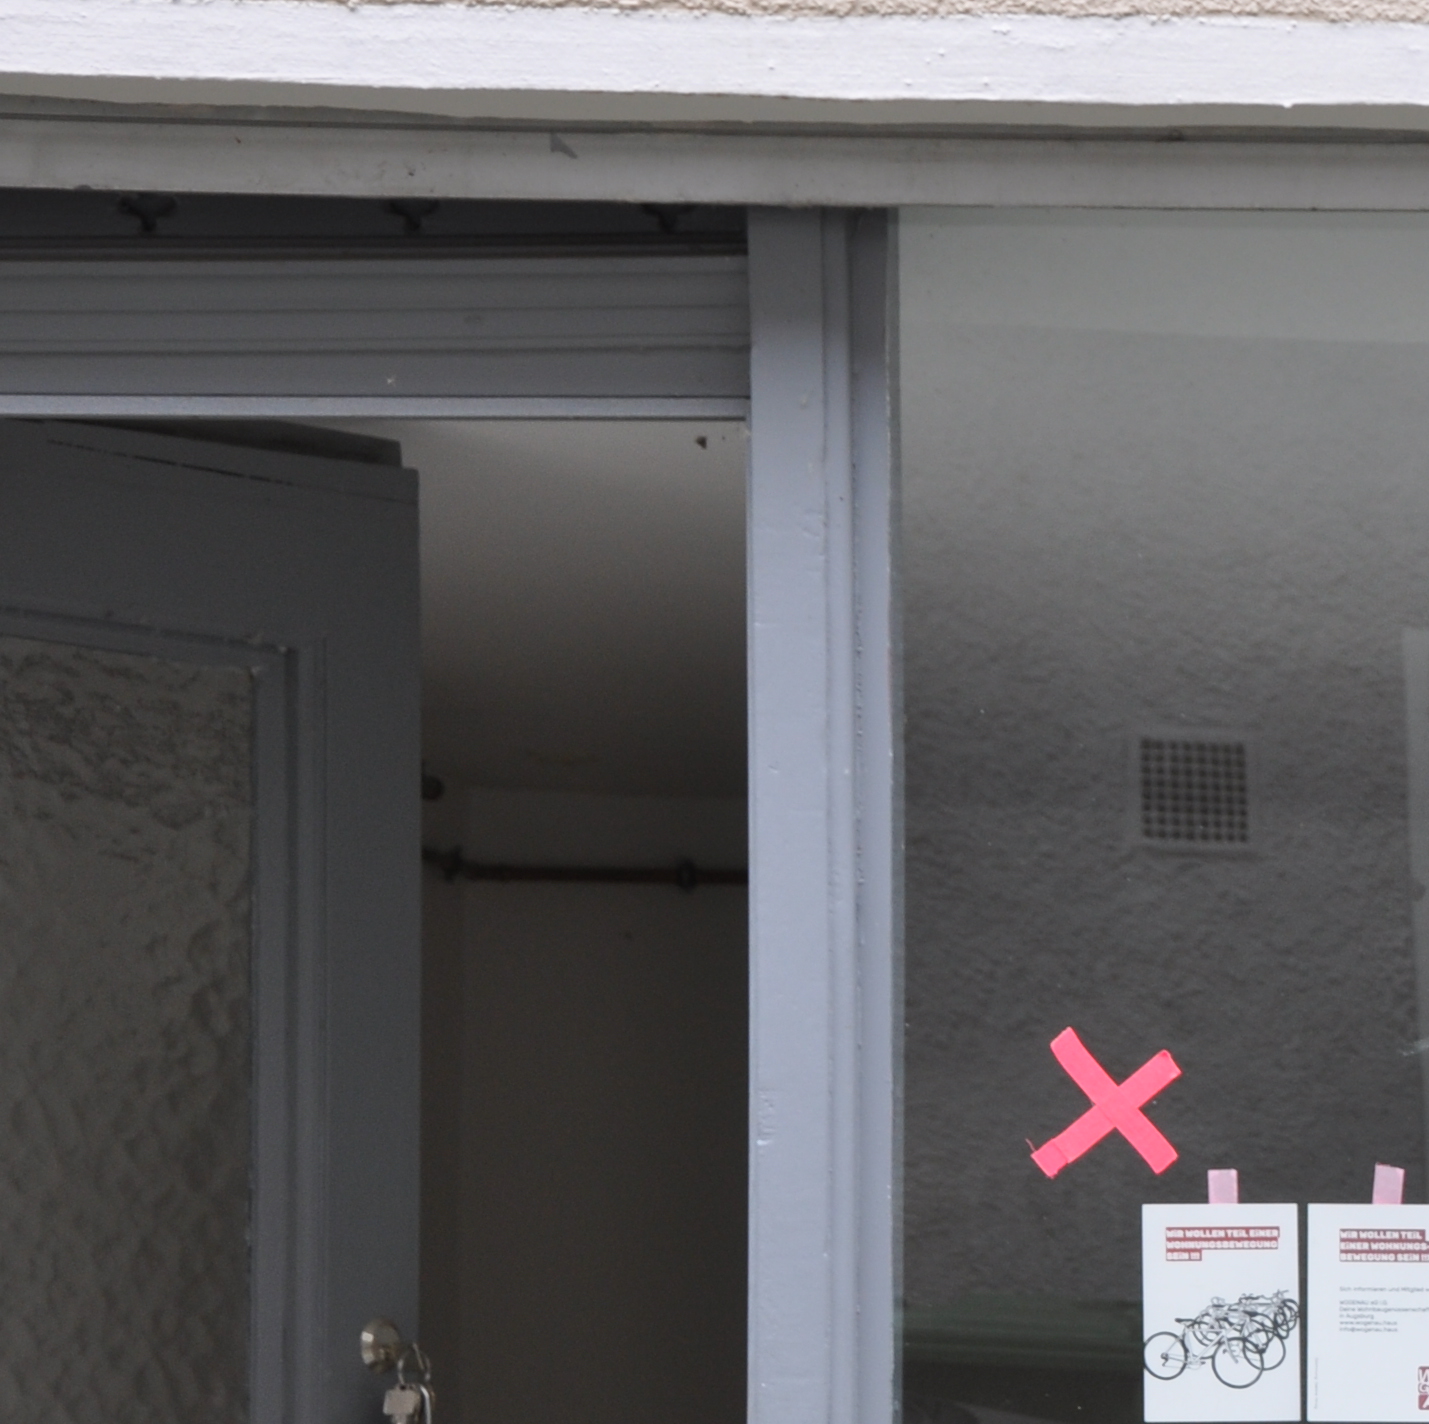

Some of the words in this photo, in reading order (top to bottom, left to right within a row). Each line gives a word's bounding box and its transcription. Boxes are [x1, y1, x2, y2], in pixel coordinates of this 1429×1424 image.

[1185, 1229, 1225, 1238] WOLLEN
[1359, 1231, 1399, 1239] WOLLEN
[1166, 1240, 1278, 1249] WOHNUNGSBEWEGUNG
[1340, 1253, 1395, 1261] BEWEGUNG
